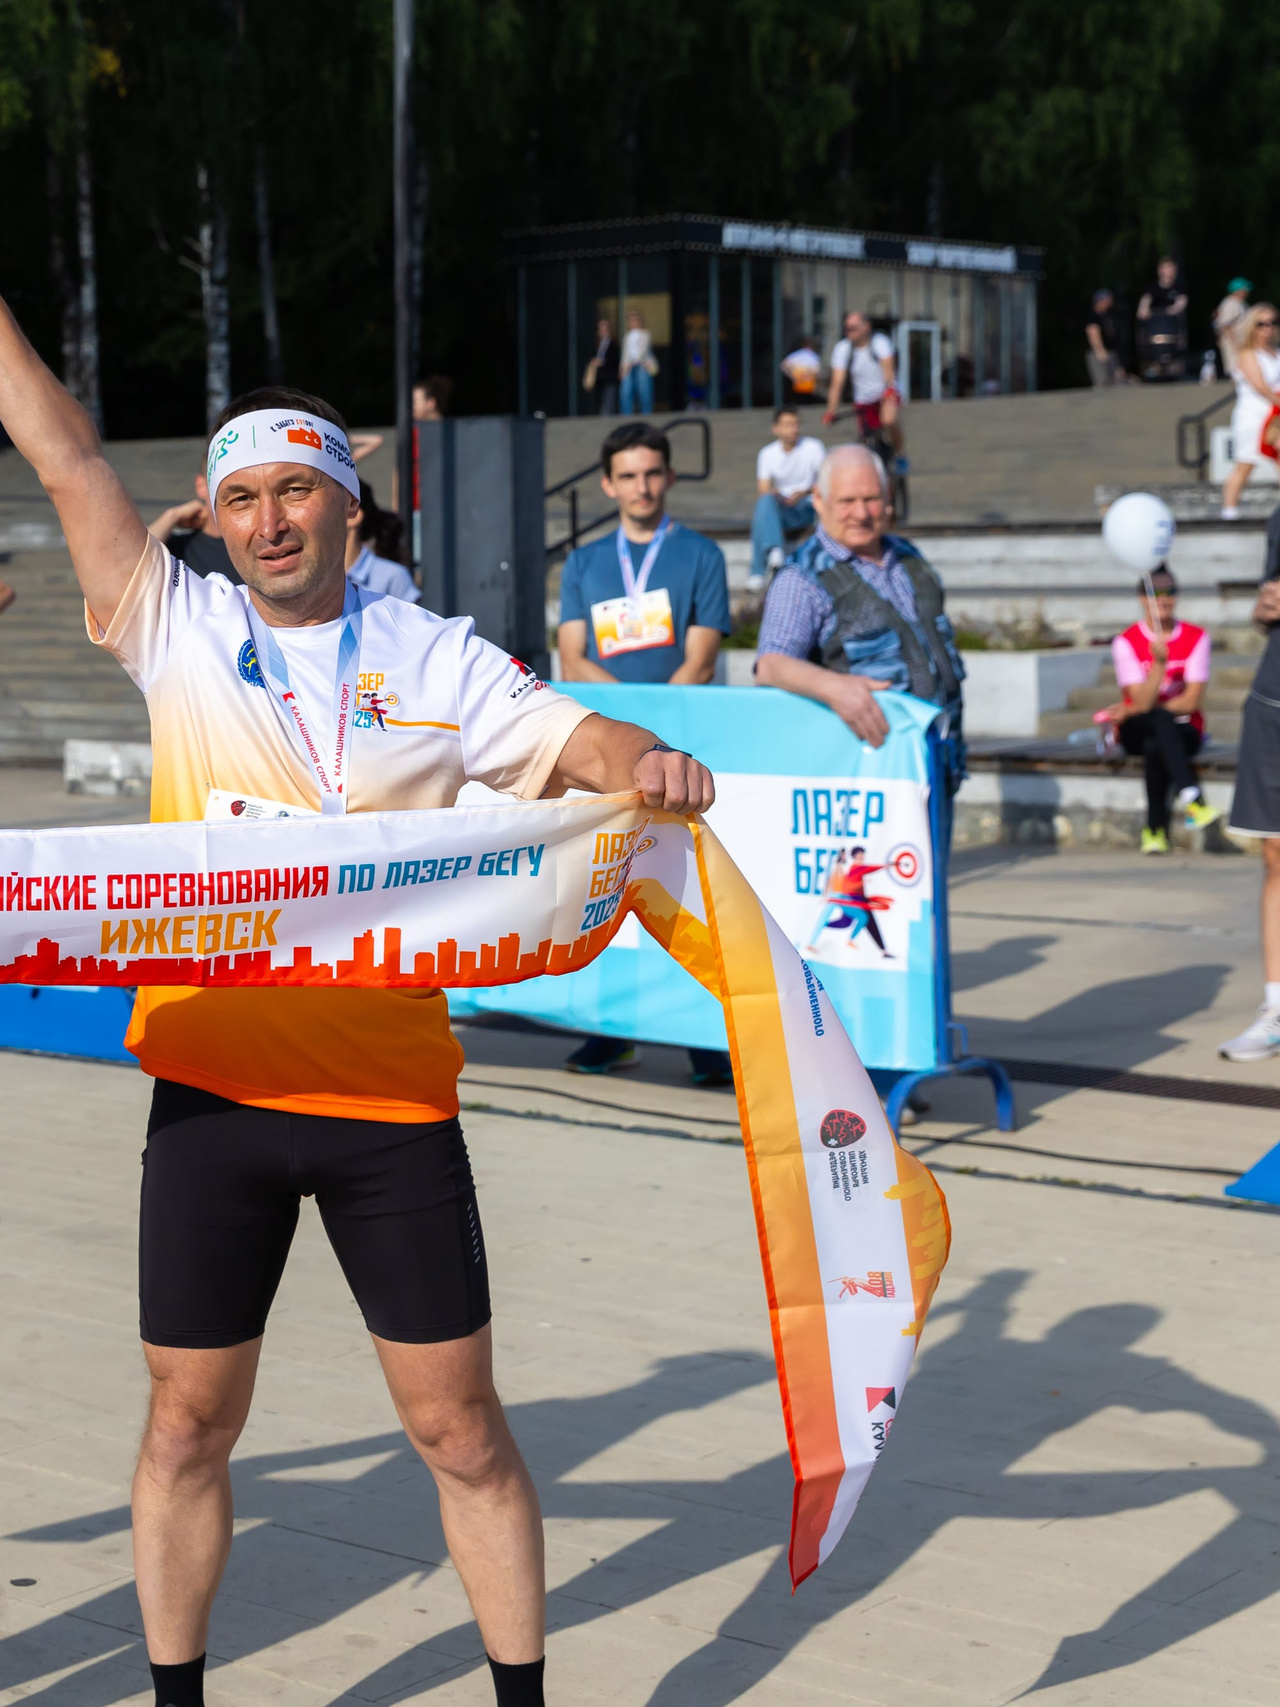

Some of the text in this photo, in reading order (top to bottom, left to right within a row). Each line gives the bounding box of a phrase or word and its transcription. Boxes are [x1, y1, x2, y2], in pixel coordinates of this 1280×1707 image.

[357, 673, 384, 691] ЗЕР
[334, 683, 350, 776] КАЛАШНИКОВ СПОРТ
[354, 710, 372, 729] 25
[290, 705, 333, 794] КАЛАШНИКОВ СПОРТ
[106, 866, 329, 911] СОРЕВНОВАНИЯ
[337, 863, 375, 895] ПО
[382, 855, 473, 890] ЛАЗЕР
[477, 843, 546, 877] БЕГУ
[99, 908, 282, 956] ИЖЕВСК
